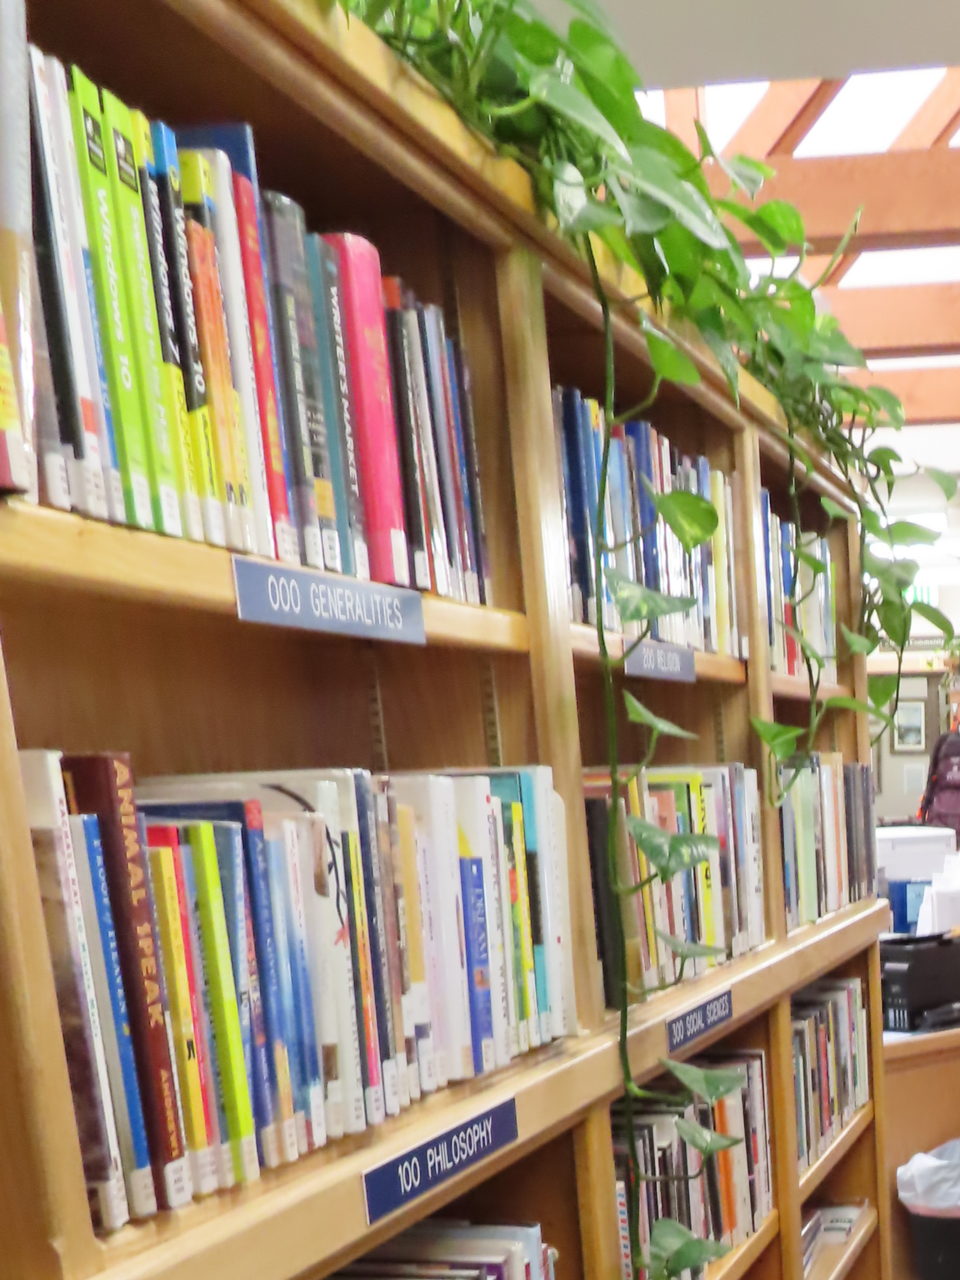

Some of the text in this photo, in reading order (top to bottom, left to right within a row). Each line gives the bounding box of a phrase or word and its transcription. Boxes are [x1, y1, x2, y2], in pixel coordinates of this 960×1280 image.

[96, 187, 132, 389] Windows 10
[146, 177, 181, 364] Windows 7
[173, 206, 205, 394] Windows 10
[329, 285, 358, 496] WRITER'S MARKET
[310, 582, 403, 630] GENERALITIES
[107, 930, 126, 1014] HEAVEN
[113, 760, 165, 1029] ANIMAL SPEAK
[672, 994, 729, 1045] 300 SOCIAL SCIENCES
[397, 1116, 493, 1195] 100 PHILOSOPHY
